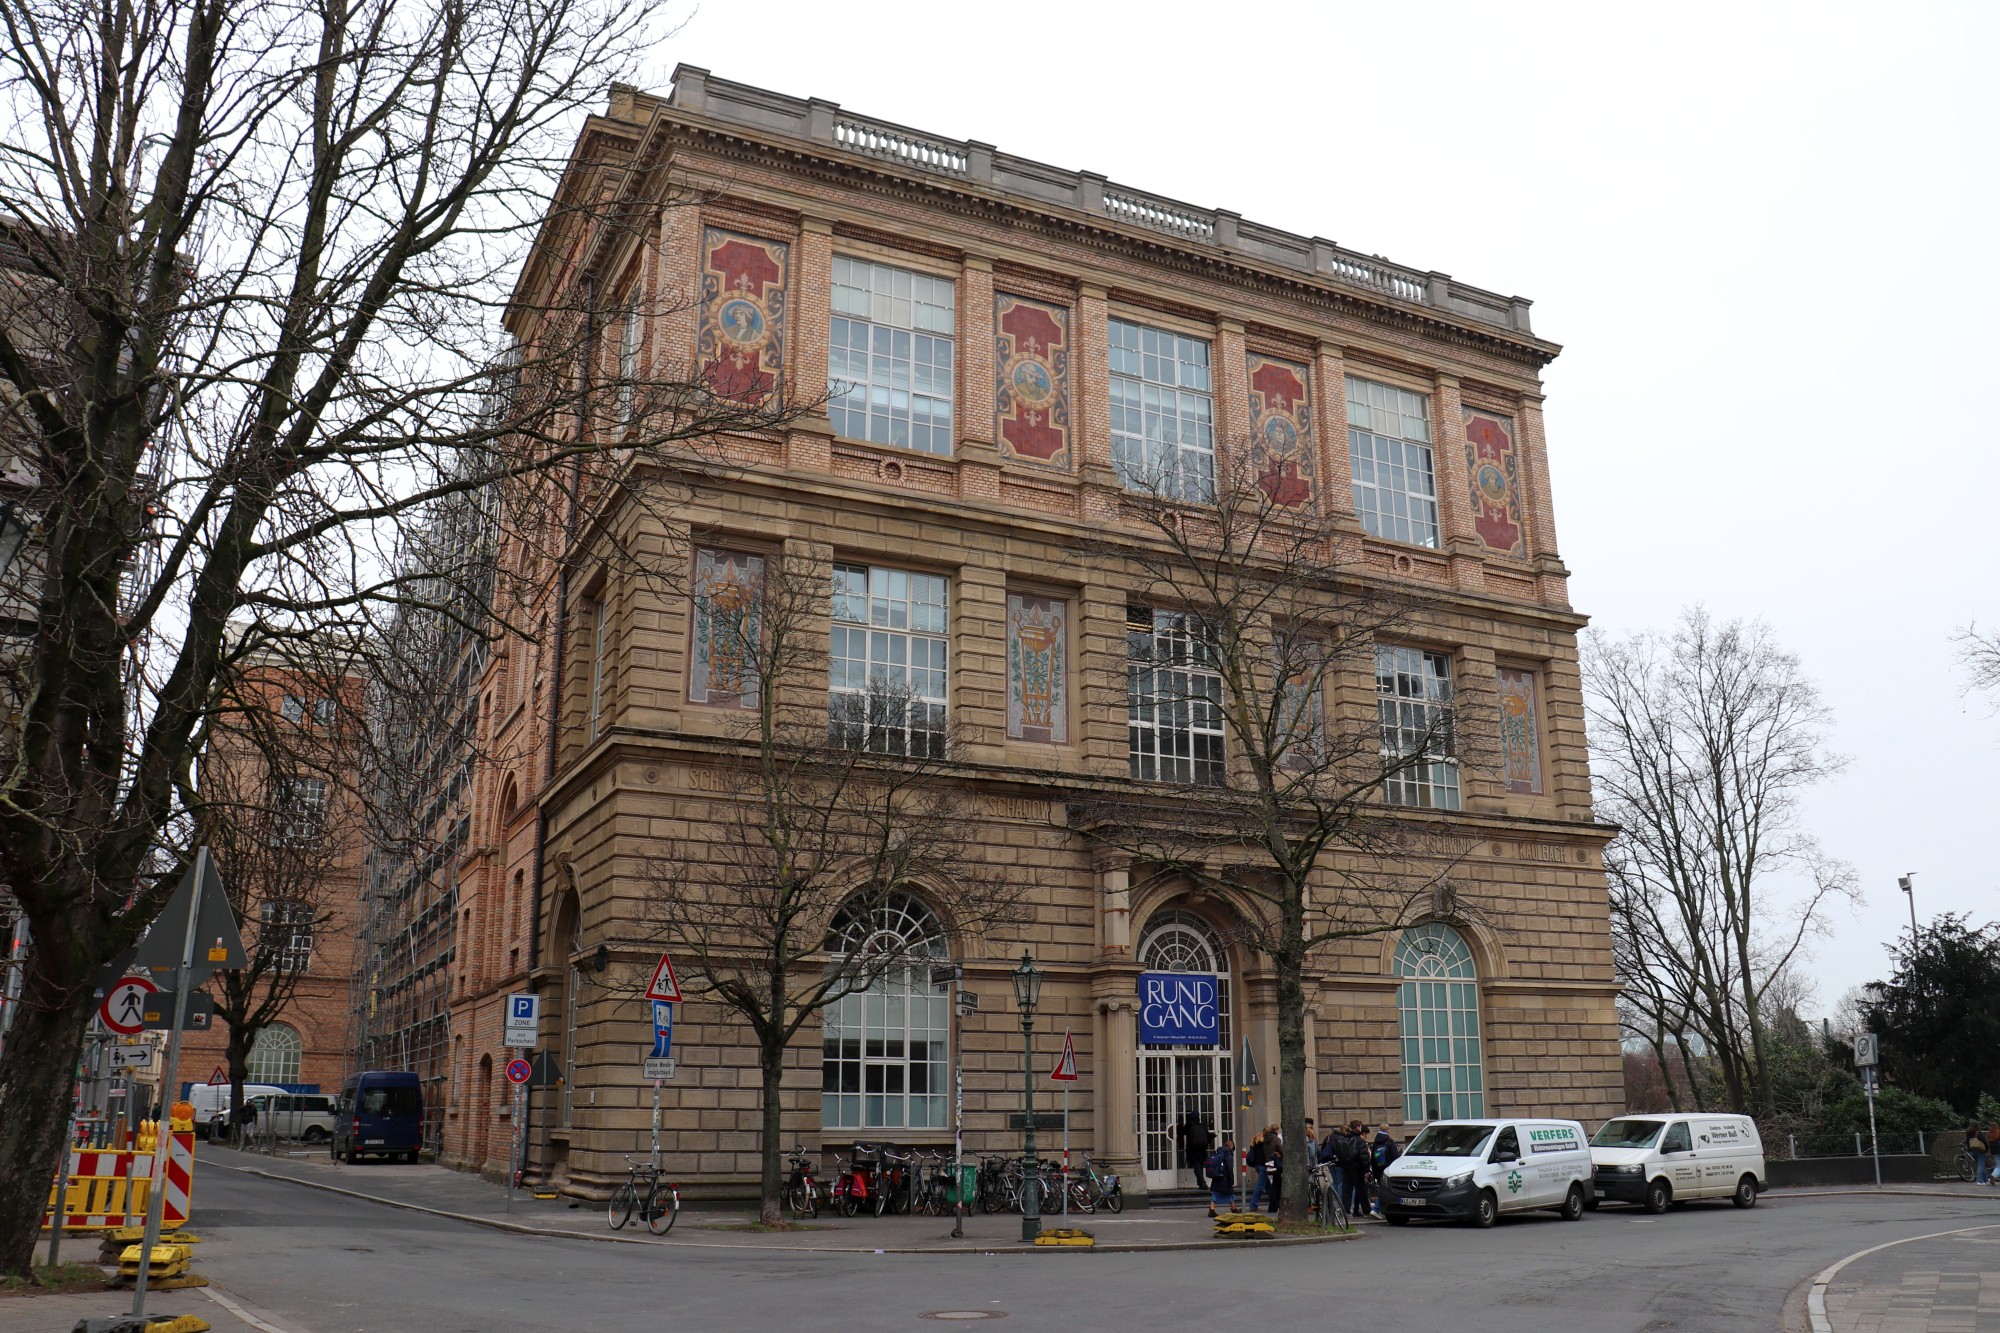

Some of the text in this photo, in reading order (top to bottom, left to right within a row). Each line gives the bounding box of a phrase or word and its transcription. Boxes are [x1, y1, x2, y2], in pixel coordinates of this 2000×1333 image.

[988, 796, 1050, 821] SCHADOW
[1519, 841, 1567, 863] KAULBACH
[1147, 980, 1214, 1005] RUND
[1143, 1003, 1216, 1029] GANG
[1530, 1128, 1575, 1141] VERFERS
